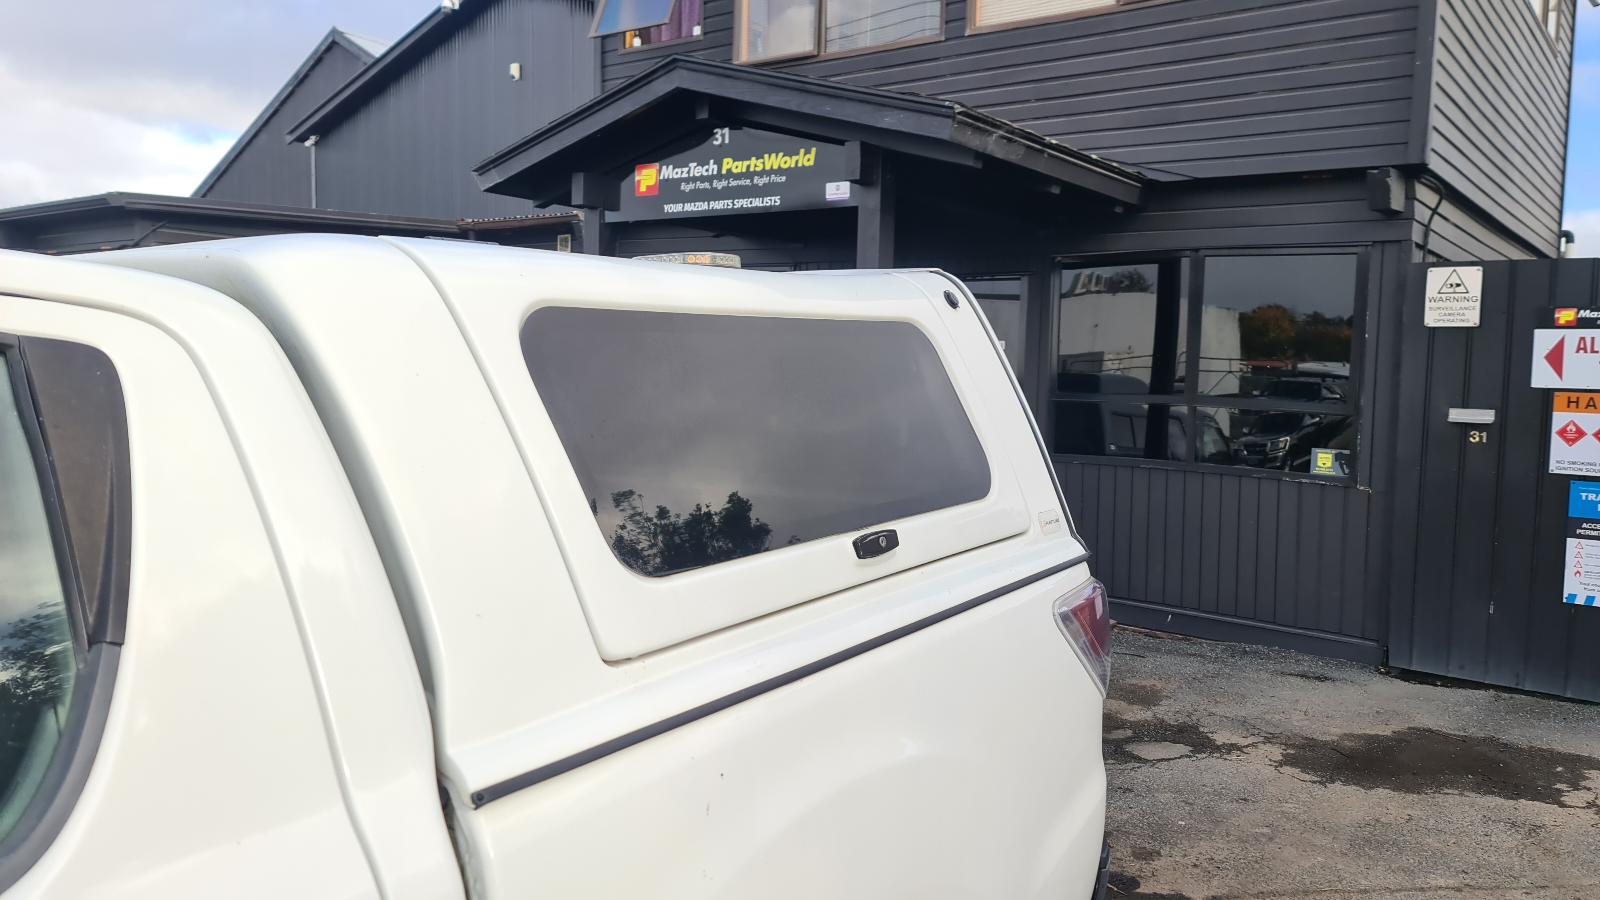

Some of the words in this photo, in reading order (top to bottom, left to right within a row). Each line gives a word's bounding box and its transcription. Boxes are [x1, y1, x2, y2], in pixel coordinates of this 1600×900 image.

[712, 127, 730, 145] 31
[660, 160, 718, 180] MazTech
[721, 148, 816, 174] PartsWorld
[680, 181, 696, 192] Right
[712, 178, 729, 189] Right
[728, 177, 752, 188] Service,
[753, 174, 770, 187] Right
[770, 174, 787, 184] Price
[663, 203, 683, 213] YOUR
[683, 201, 709, 212] MAZDA
[709, 199, 733, 210] PARTS
[733, 195, 781, 209] SPECIALISTS
[1469, 431, 1487, 443] 31
